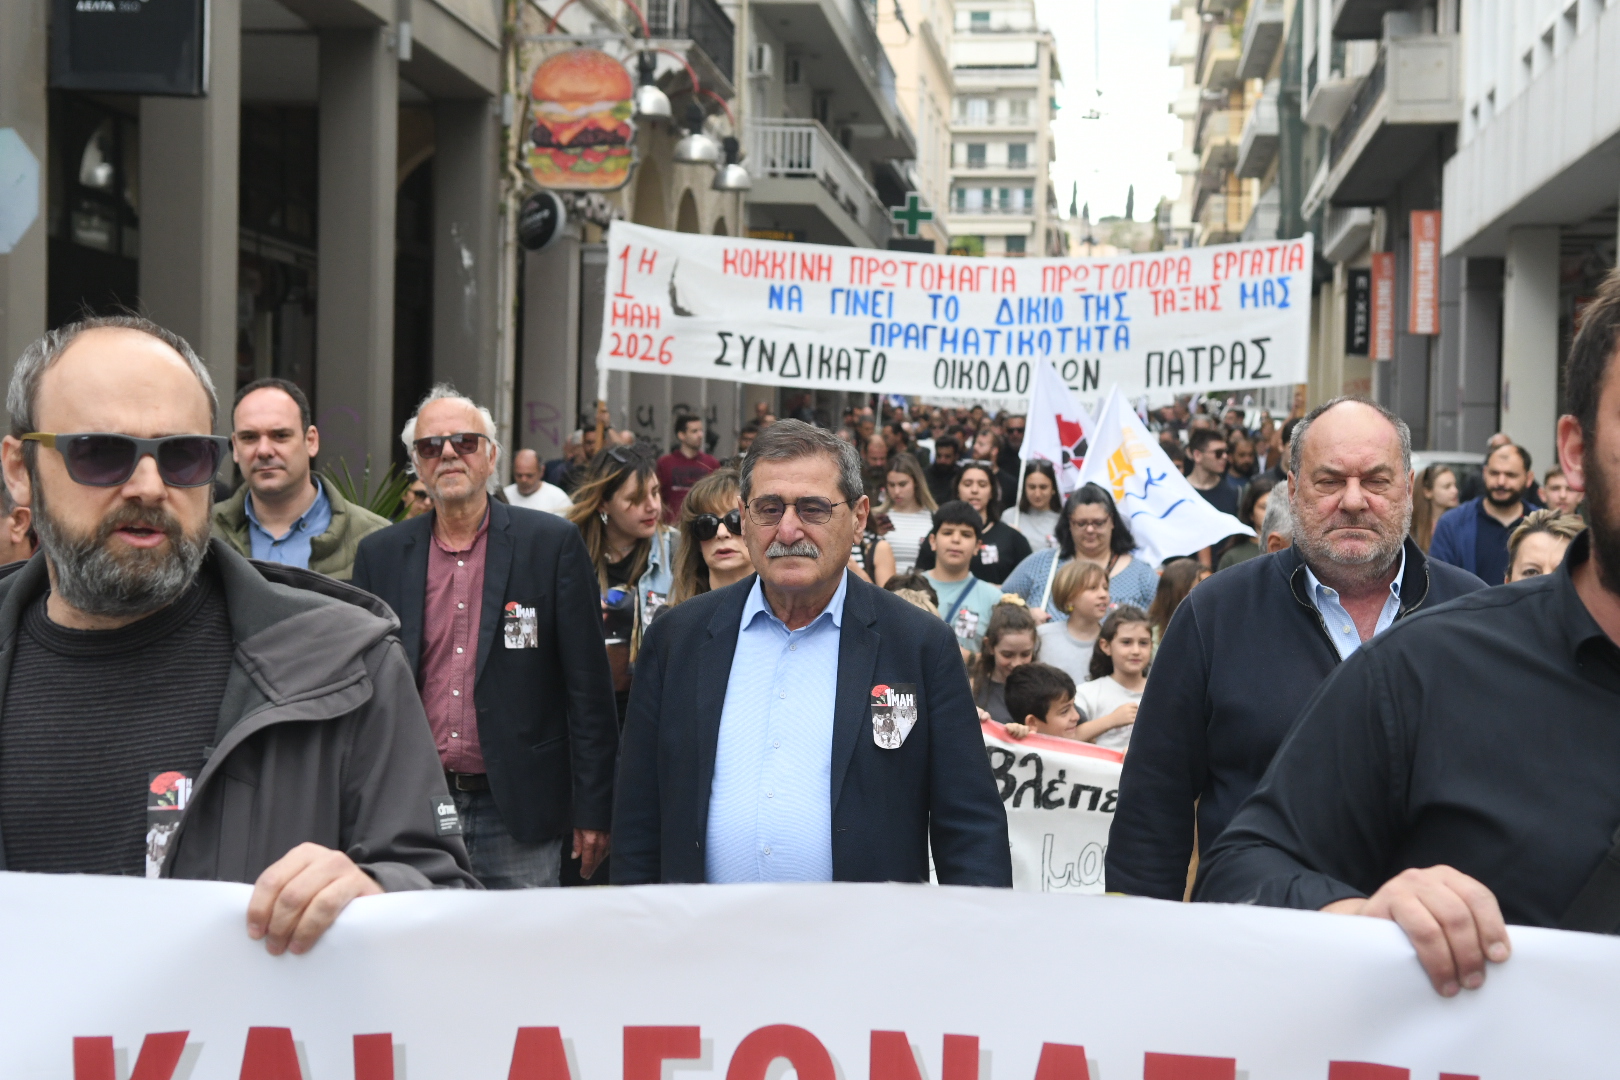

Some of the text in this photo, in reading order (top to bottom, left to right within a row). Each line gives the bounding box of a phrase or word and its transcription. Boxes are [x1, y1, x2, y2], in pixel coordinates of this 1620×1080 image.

[722, 243, 1305, 293] ΚΟΚΚΙΝΗ ΠΡΩΤΟΜΑΓΙΑ ΠΡΩΤΟΠΟΡΑ ΕΡΓΑΤΙΑ
[768, 276, 1293, 326] ΝΑ ΓΙΝΕΙ ΤΟ ΔΙΚΙΟ ΤΗΣ ΤΑΞΗΣ ΜΑΣ
[610, 332, 675, 365] 2026
[870, 322, 1132, 357] ΠΡΑΓΜΑΤΙΚΟΤΗΤΑ
[714, 332, 1272, 394] ΣΥΝΔΙΚΑΤΟ ΟΙΚΟΔΟΩΝ ΠΑΤΡΑΣ
[892, 693, 914, 707] ΜΑΗ
